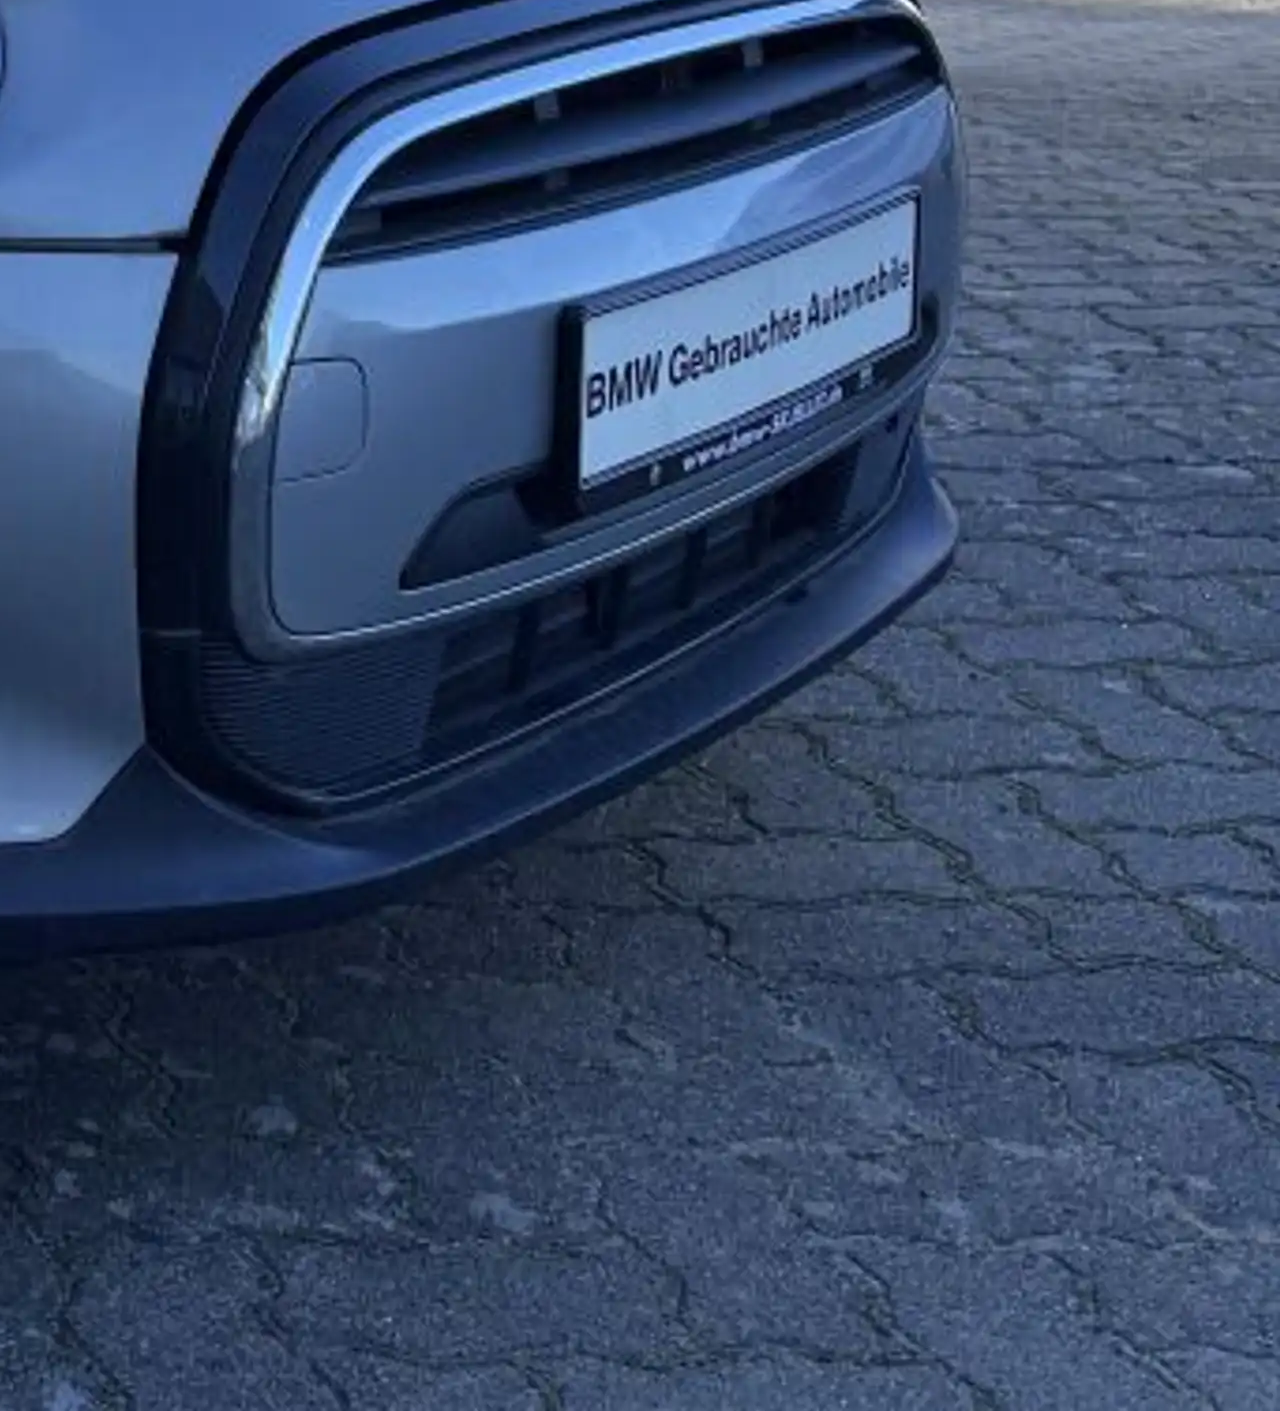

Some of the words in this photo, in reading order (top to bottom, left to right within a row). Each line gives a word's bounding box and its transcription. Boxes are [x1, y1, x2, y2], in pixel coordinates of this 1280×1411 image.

[586, 350, 662, 418] BMW
[668, 308, 802, 387] Gebrauchte
[807, 257, 910, 329] Automobile
